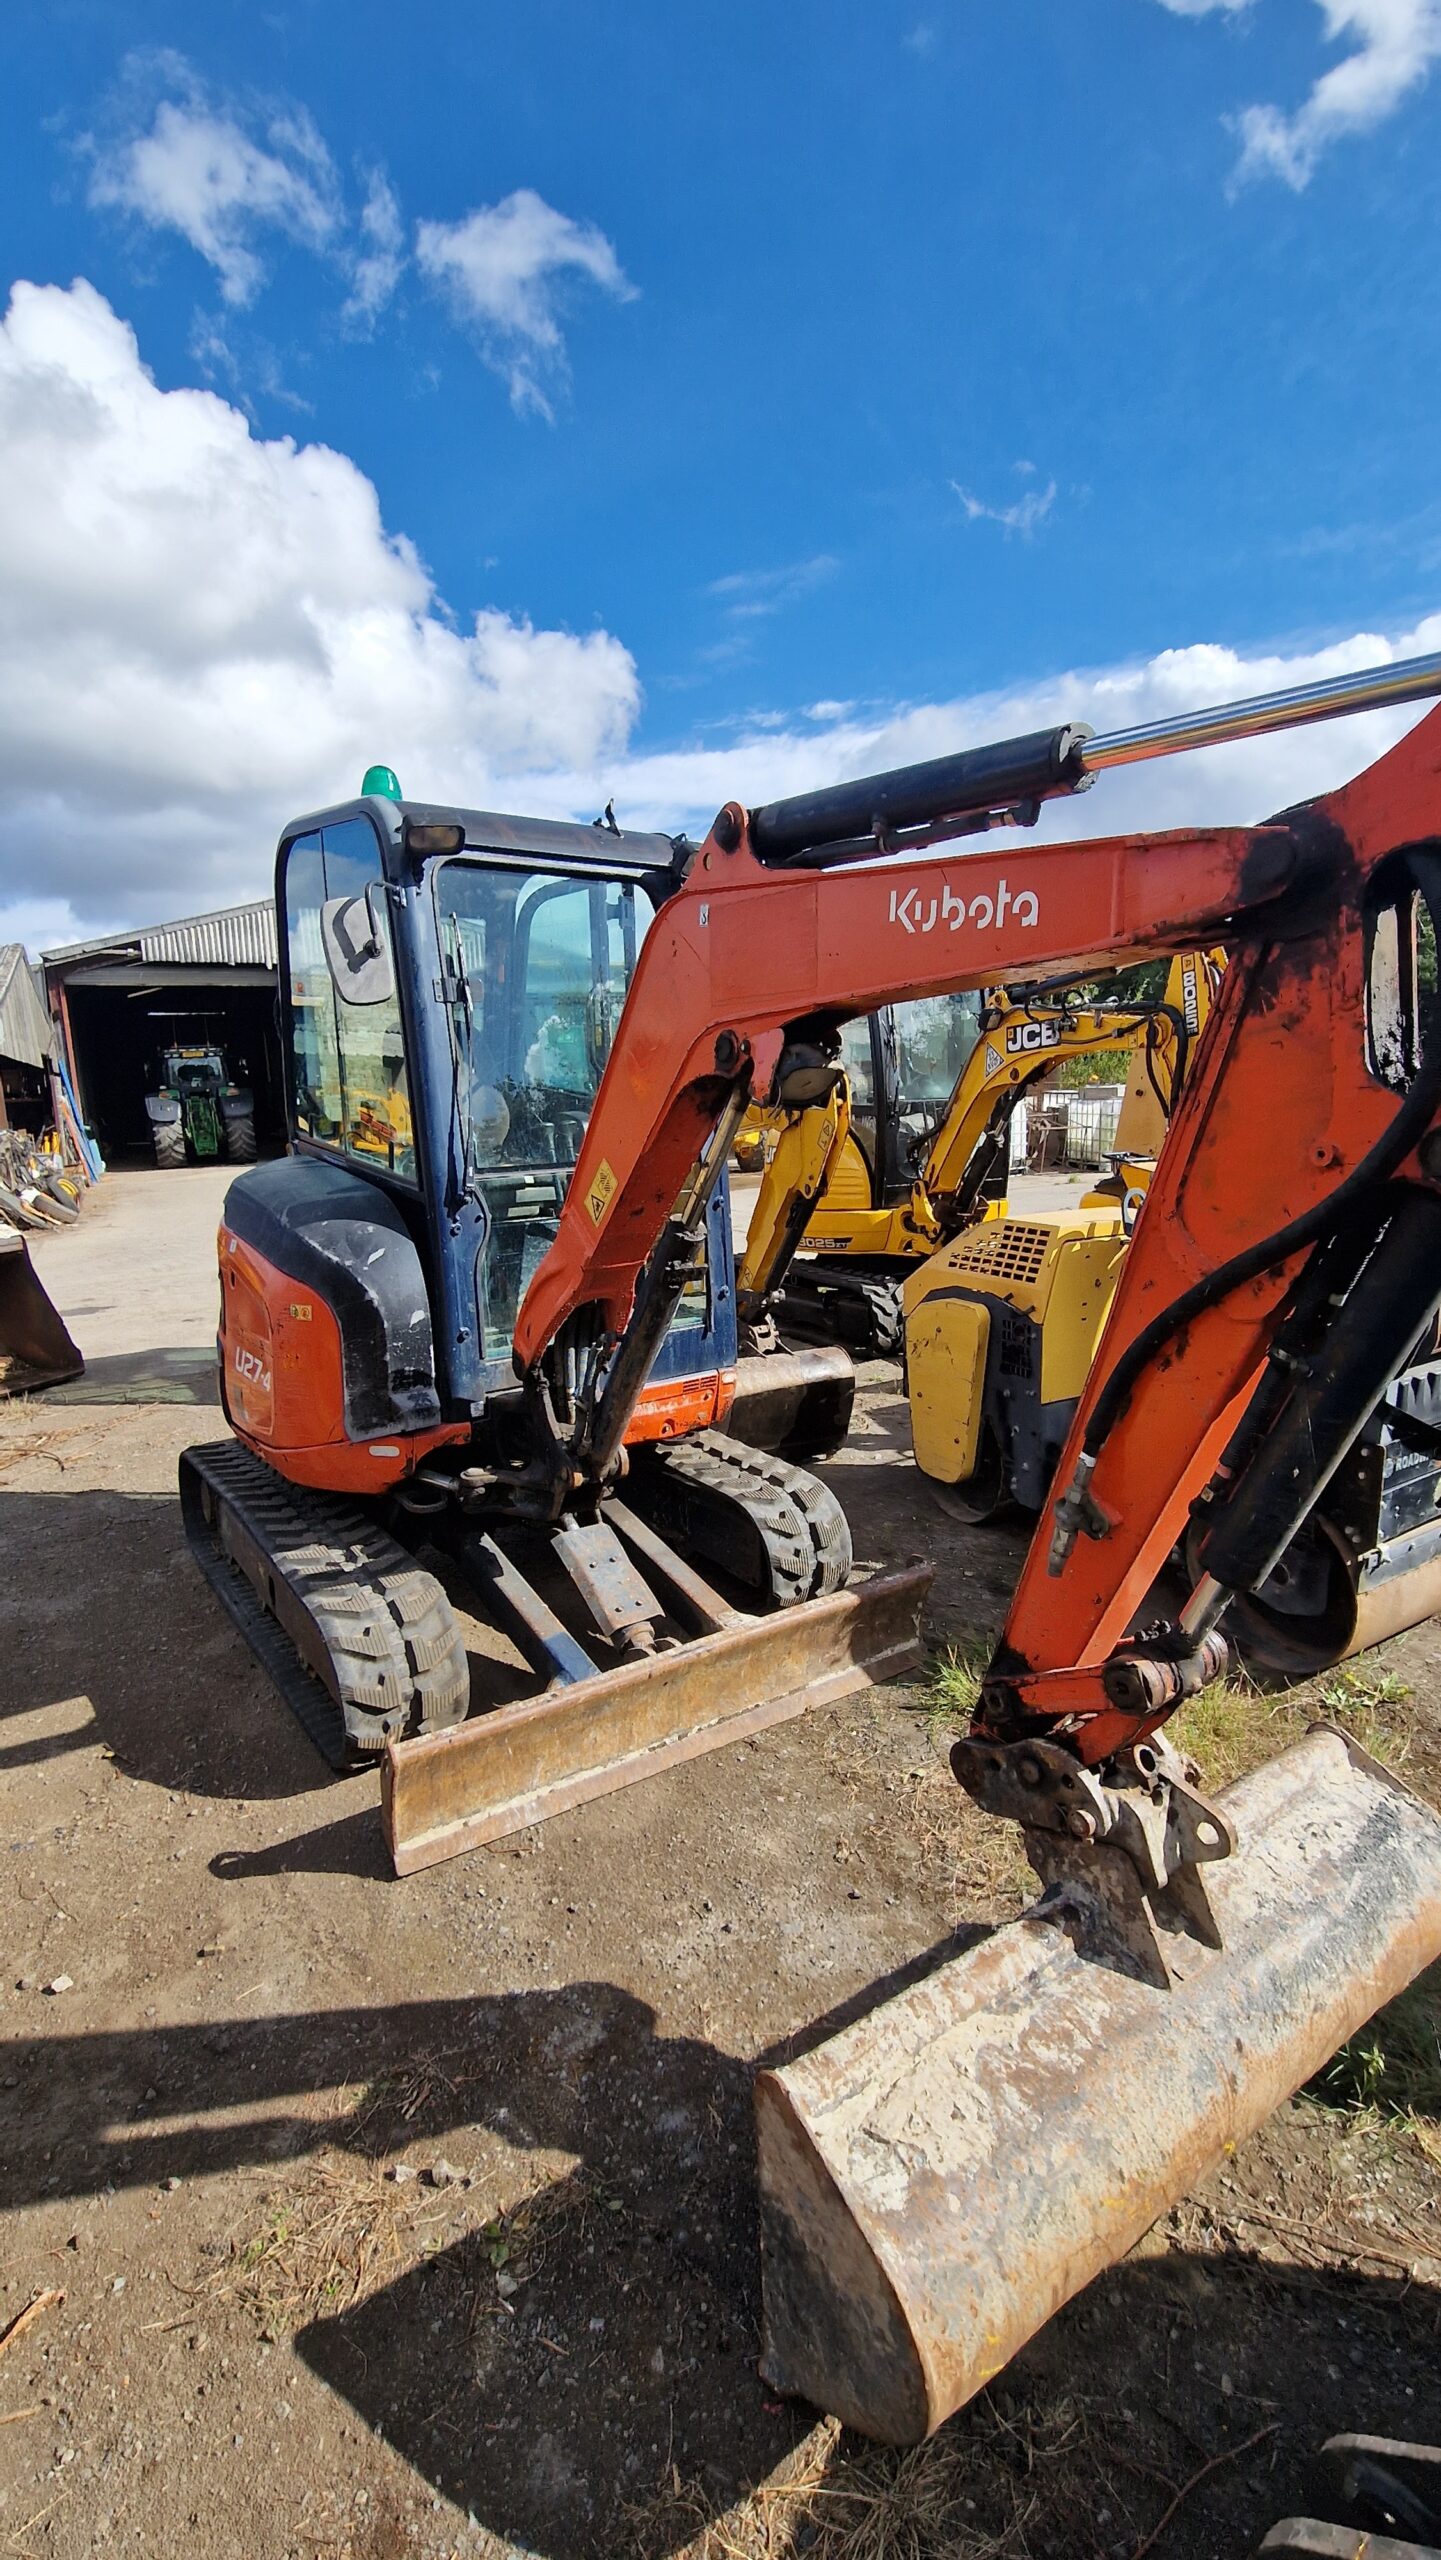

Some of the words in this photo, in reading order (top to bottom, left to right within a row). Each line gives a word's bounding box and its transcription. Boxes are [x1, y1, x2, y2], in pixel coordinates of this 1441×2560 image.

[888, 879, 1040, 934] Kubota
[1183, 970, 1198, 1029] 8025
[1007, 1020, 1060, 1052] JCB
[235, 1346, 271, 1392] U27-4
